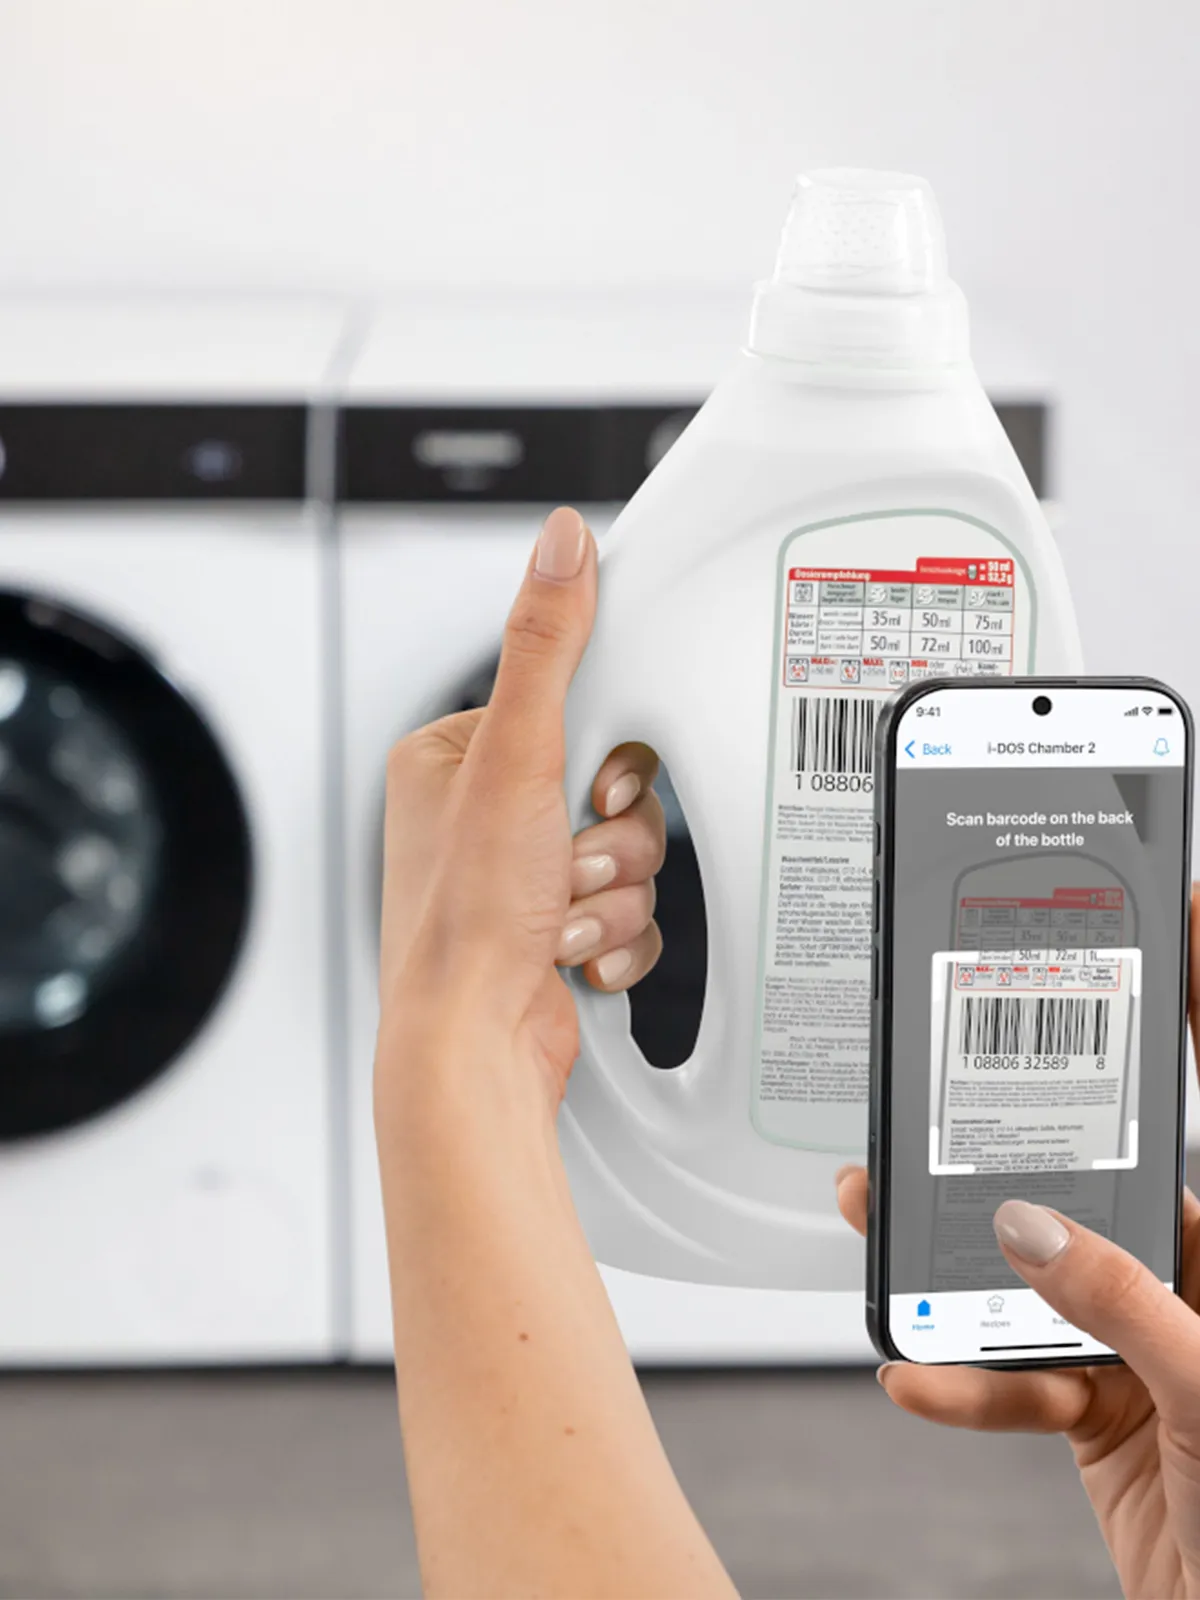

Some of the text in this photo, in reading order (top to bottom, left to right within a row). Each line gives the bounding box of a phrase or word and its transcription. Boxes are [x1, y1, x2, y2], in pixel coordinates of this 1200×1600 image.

[915, 706, 942, 718] 9:41
[922, 743, 952, 756] Back
[987, 742, 1096, 755] i-DOS Chamber 2
[795, 773, 874, 794] 1 08806
[946, 810, 1134, 827] Scan barcode on the back
[995, 831, 1085, 847] of the bottle
[962, 1055, 1106, 1071] 1 08806 32589 8
